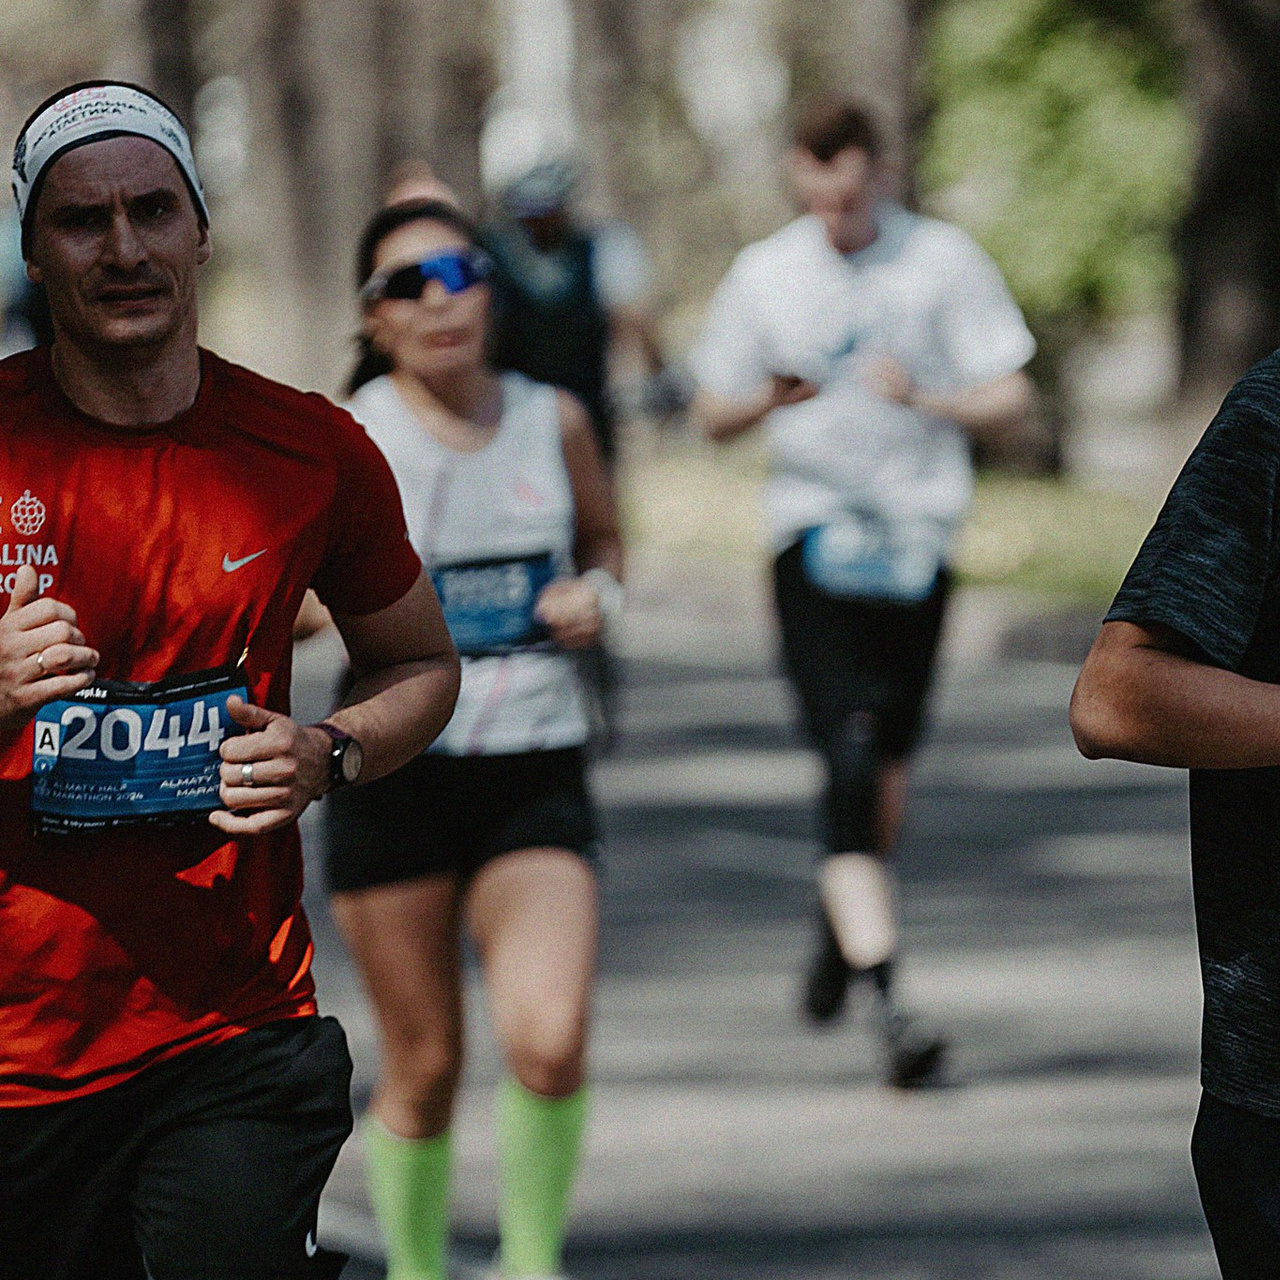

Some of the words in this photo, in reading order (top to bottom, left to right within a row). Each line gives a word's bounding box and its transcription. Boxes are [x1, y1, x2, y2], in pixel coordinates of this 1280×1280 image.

[48, 108, 122, 138] АТЛЕТИКА
[0, 544, 59, 566] LINA
[39, 728, 55, 750] A
[61, 700, 225, 761] 2044
[53, 781, 95, 792] ALMATY
[160, 774, 214, 789] ALMATY
[53, 790, 113, 801] MARATHON
[116, 791, 144, 801] 2024
[176, 784, 221, 798] MARAT
